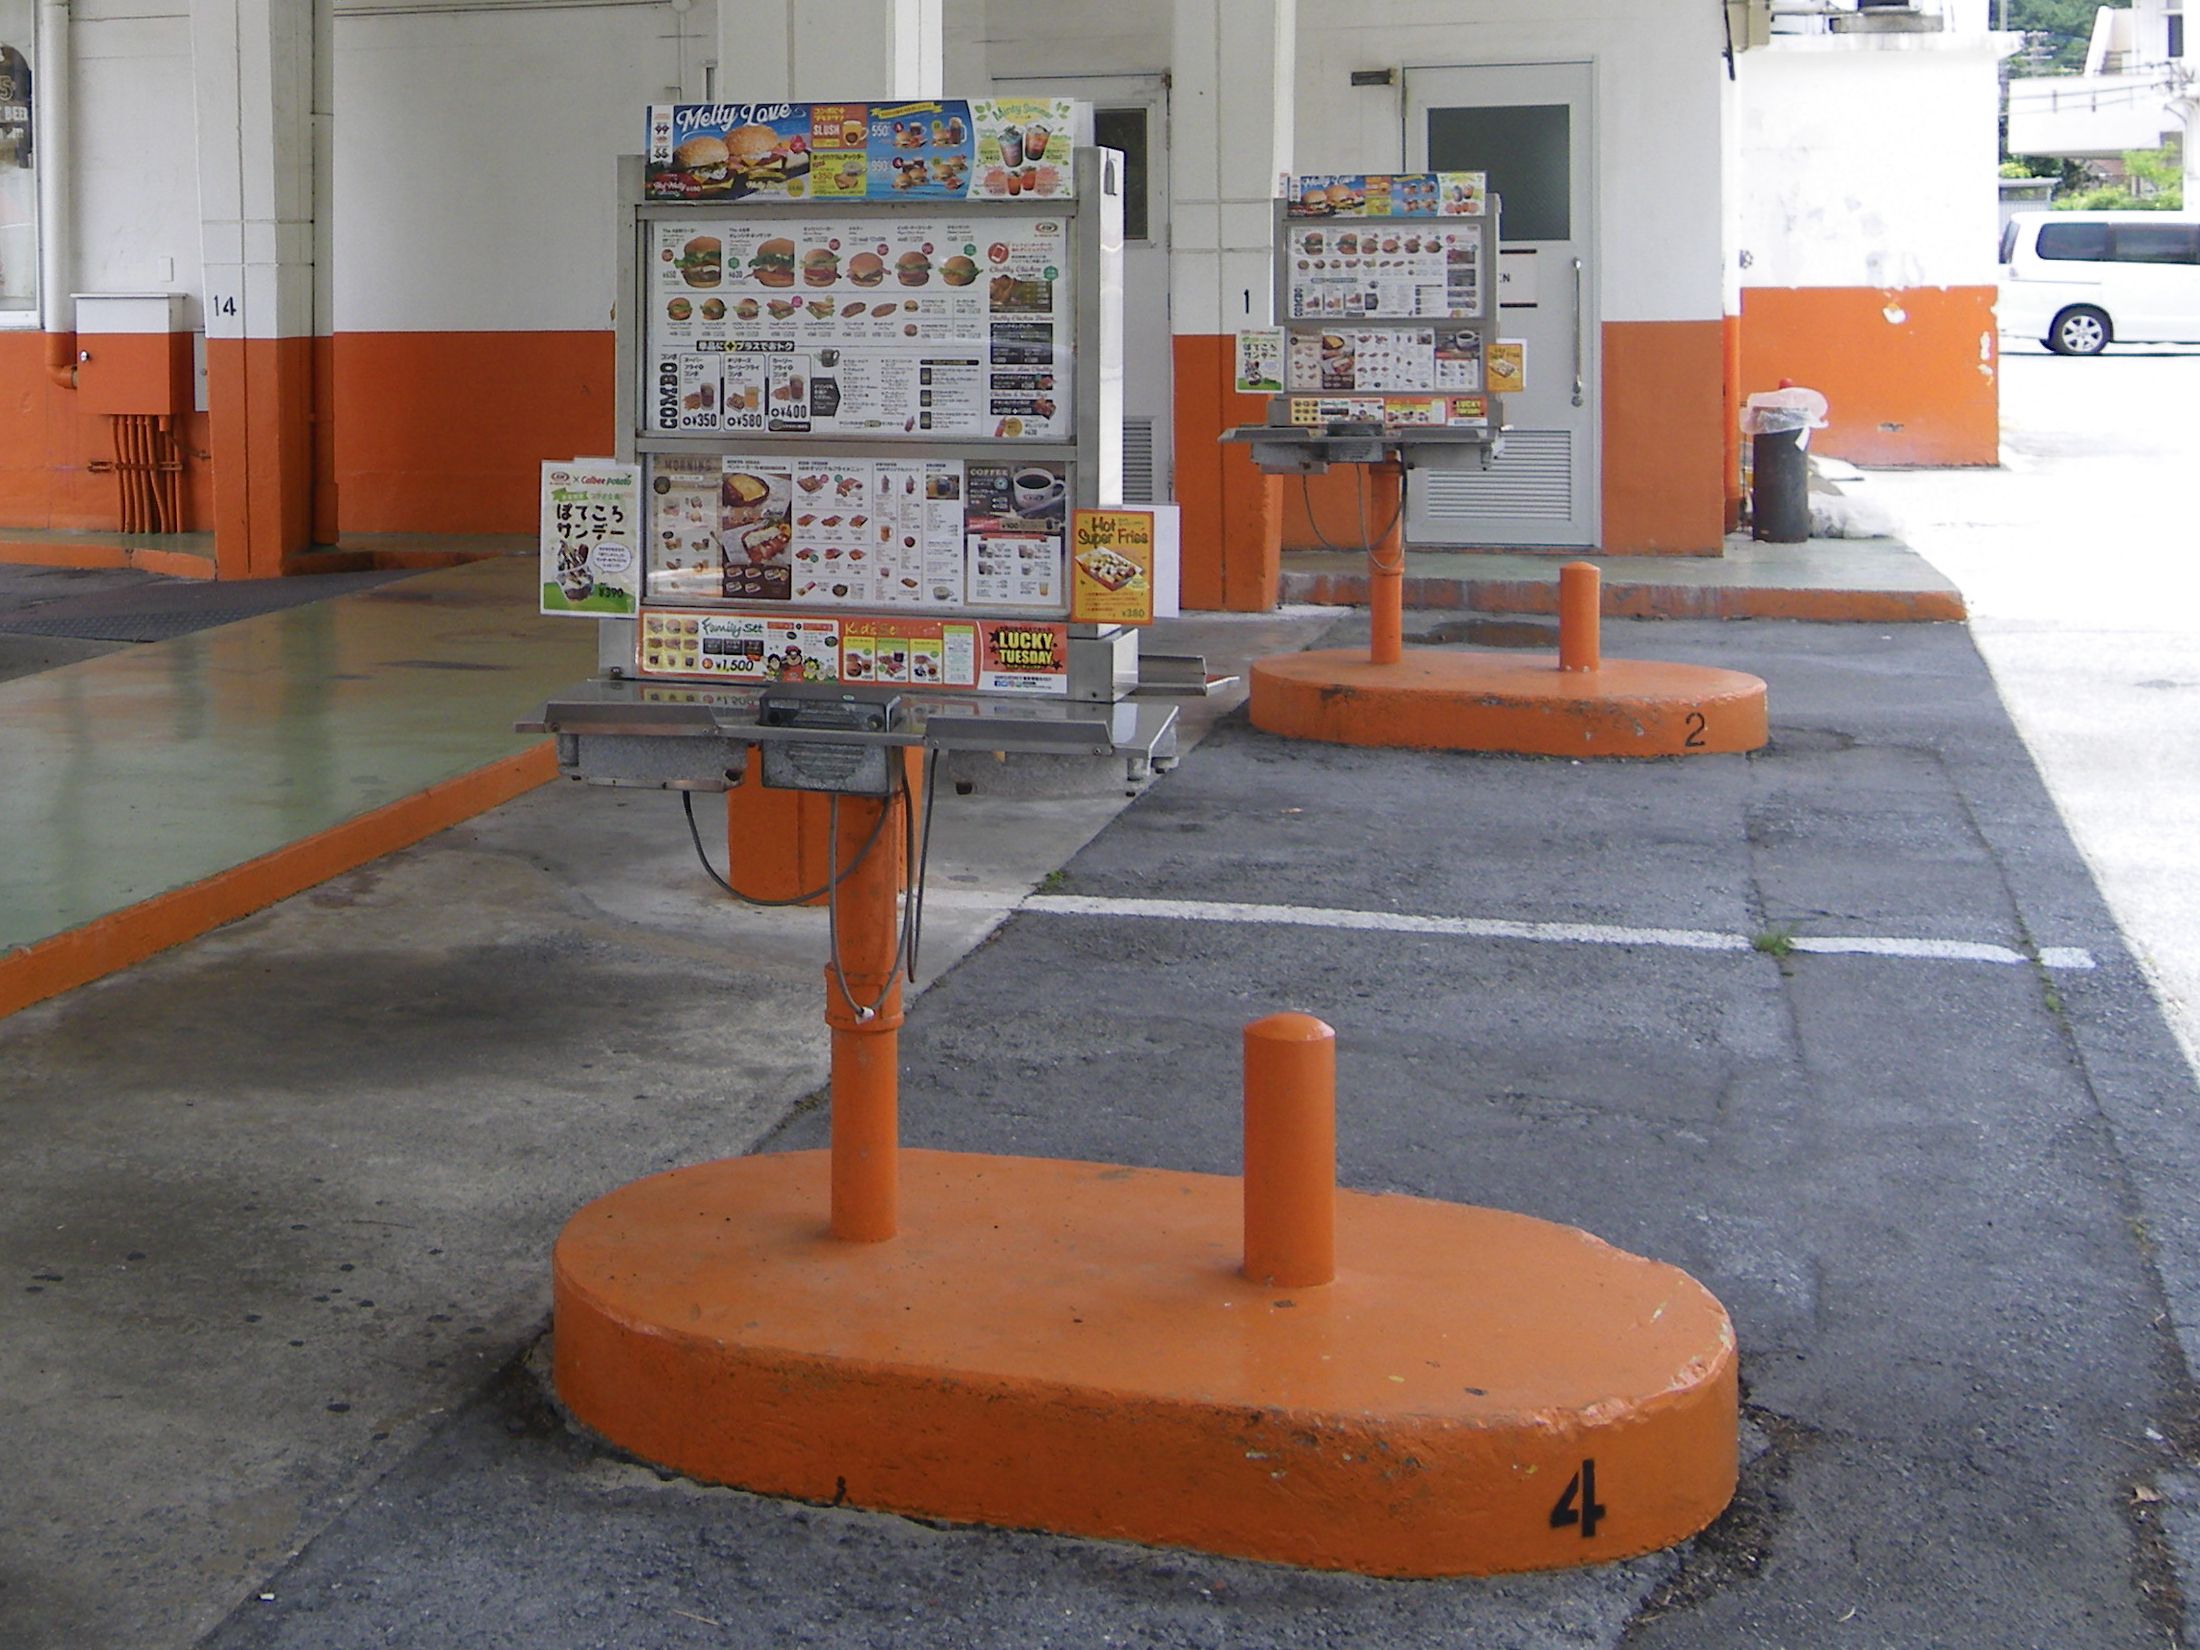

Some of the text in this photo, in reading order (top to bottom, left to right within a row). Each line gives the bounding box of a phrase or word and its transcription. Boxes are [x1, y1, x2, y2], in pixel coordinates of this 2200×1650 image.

[676, 103, 793, 131] Melty Love
[214, 295, 237, 317] 14
[1244, 289, 1249, 314] 1
[660, 362, 678, 429] COMBO
[693, 413, 717, 427] ¥350
[737, 413, 762, 427] ¥580
[781, 404, 807, 419] ¥400
[970, 468, 1008, 476] COFFEE
[557, 503, 624, 523] ぽてころ
[1092, 516, 1116, 532] Hot
[1078, 527, 1148, 548] Super Fries
[702, 617, 764, 638] Family Set
[1000, 631, 1053, 649] LUCKY
[716, 660, 754, 672] ¥1,500
[1000, 649, 1052, 665] TUESDAY
[1685, 712, 1705, 746] 2
[1550, 1459, 1606, 1537] 4
